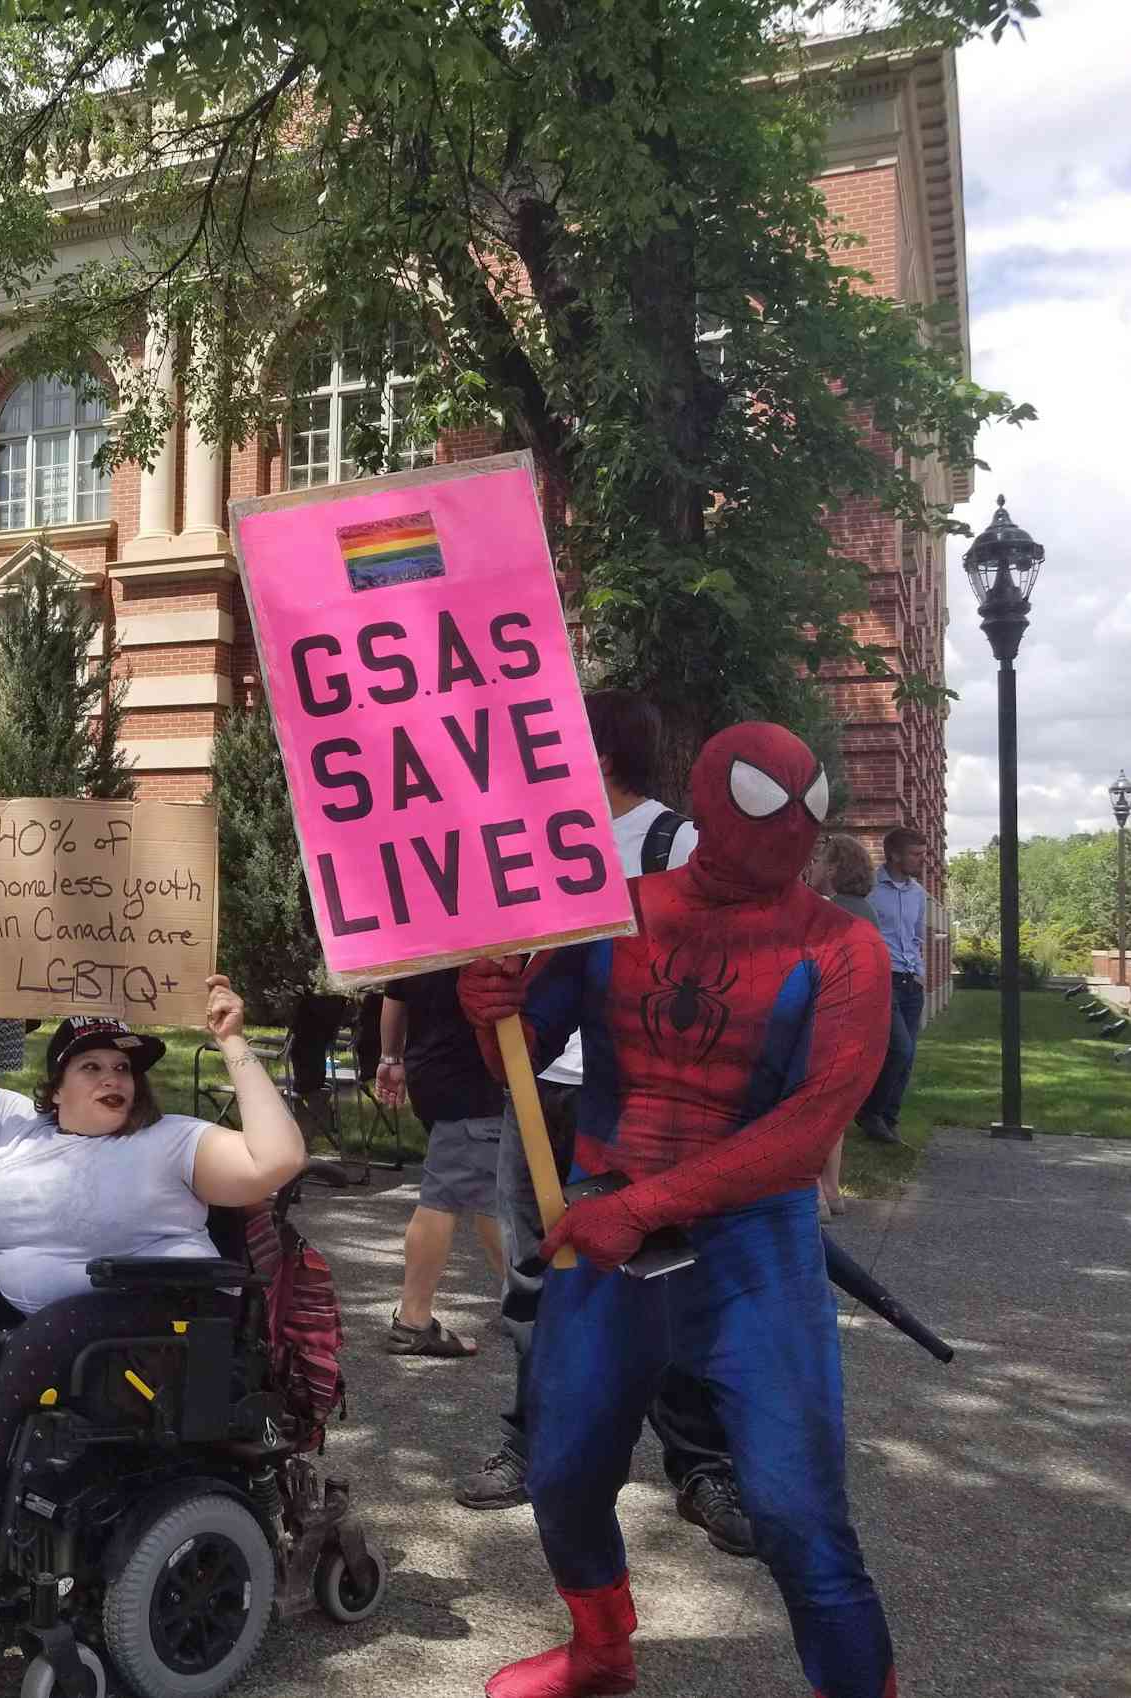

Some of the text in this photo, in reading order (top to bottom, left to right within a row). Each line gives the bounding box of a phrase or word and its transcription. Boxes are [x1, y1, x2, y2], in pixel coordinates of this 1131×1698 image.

[291, 609, 542, 719] G.S.A.S
[310, 698, 571, 824] SAVE
[93, 820, 132, 856] of
[123, 868, 202, 920] youth
[317, 808, 608, 938] LIVES
[34, 906, 135, 943] Canada
[148, 930, 201, 946] are
[16, 957, 179, 1011] LGBTQ+
